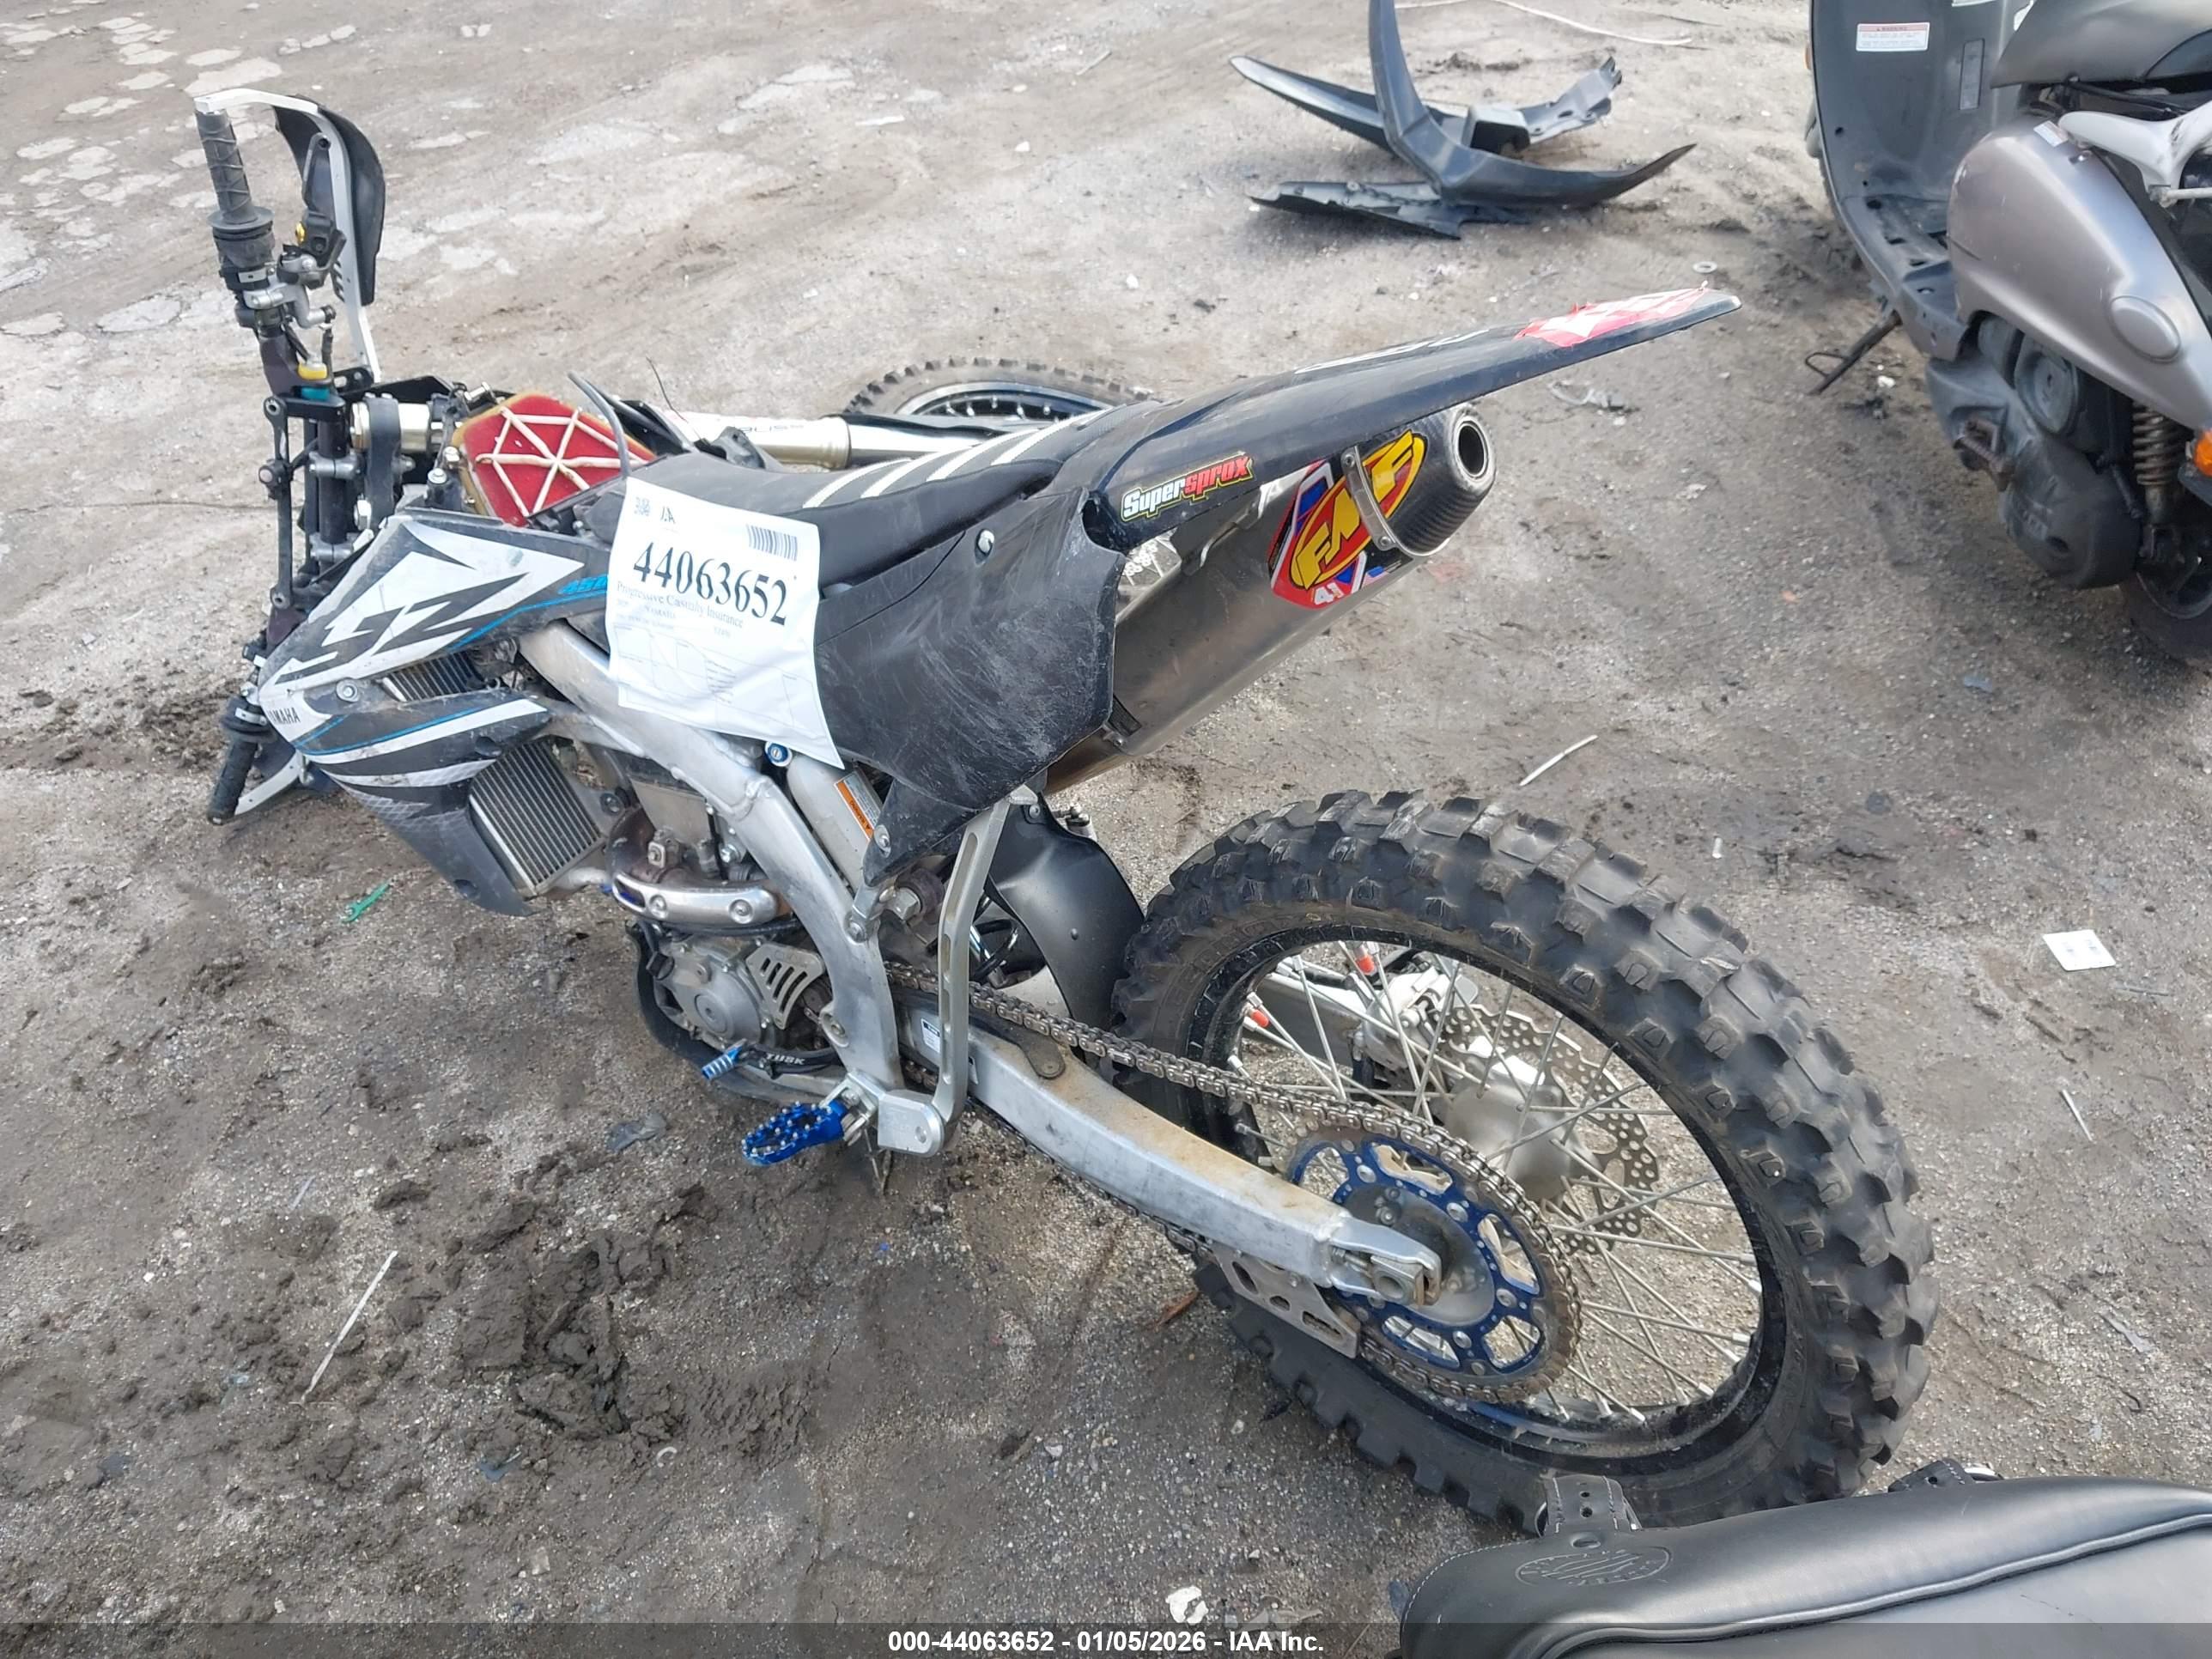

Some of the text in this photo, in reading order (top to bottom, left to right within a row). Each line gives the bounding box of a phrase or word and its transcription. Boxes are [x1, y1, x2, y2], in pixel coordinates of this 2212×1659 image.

[1123, 456, 1250, 518] Supersprox
[1296, 429, 1415, 590] FMF
[633, 542, 787, 626] 44063652
[766, 1053, 805, 1065] TUSK
